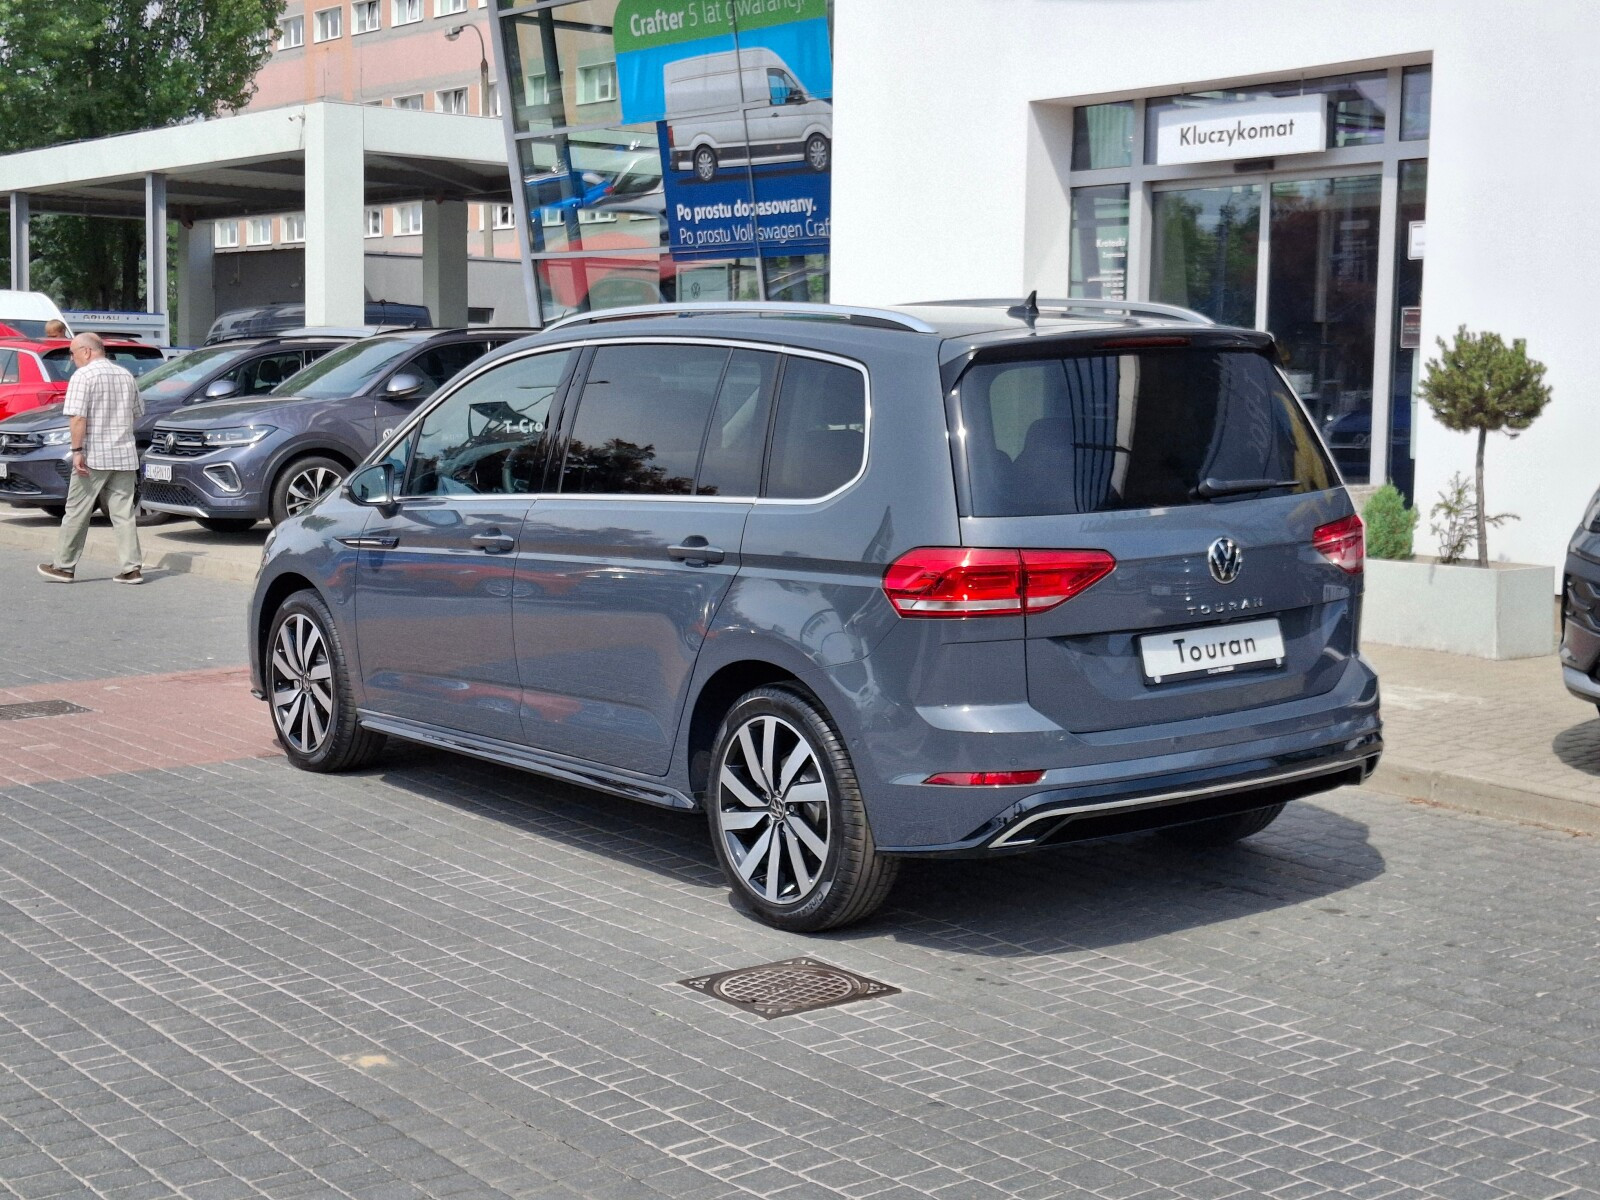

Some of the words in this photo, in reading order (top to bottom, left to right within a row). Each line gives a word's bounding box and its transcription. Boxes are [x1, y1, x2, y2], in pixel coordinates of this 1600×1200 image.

[630, 8, 685, 37] Crafter
[688, 2, 698, 27] 5
[702, 0, 722, 24] lat
[1179, 118, 1295, 148] Kluczykomat
[676, 204, 692, 221] Po
[694, 202, 732, 225] prostu
[679, 228, 694, 245] Po
[696, 228, 731, 248] prostu
[806, 217, 831, 238] Craf
[503, 418, 544, 434] T-Cro
[1186, 597, 1263, 616] TOURAN
[1172, 635, 1257, 664] Touran
